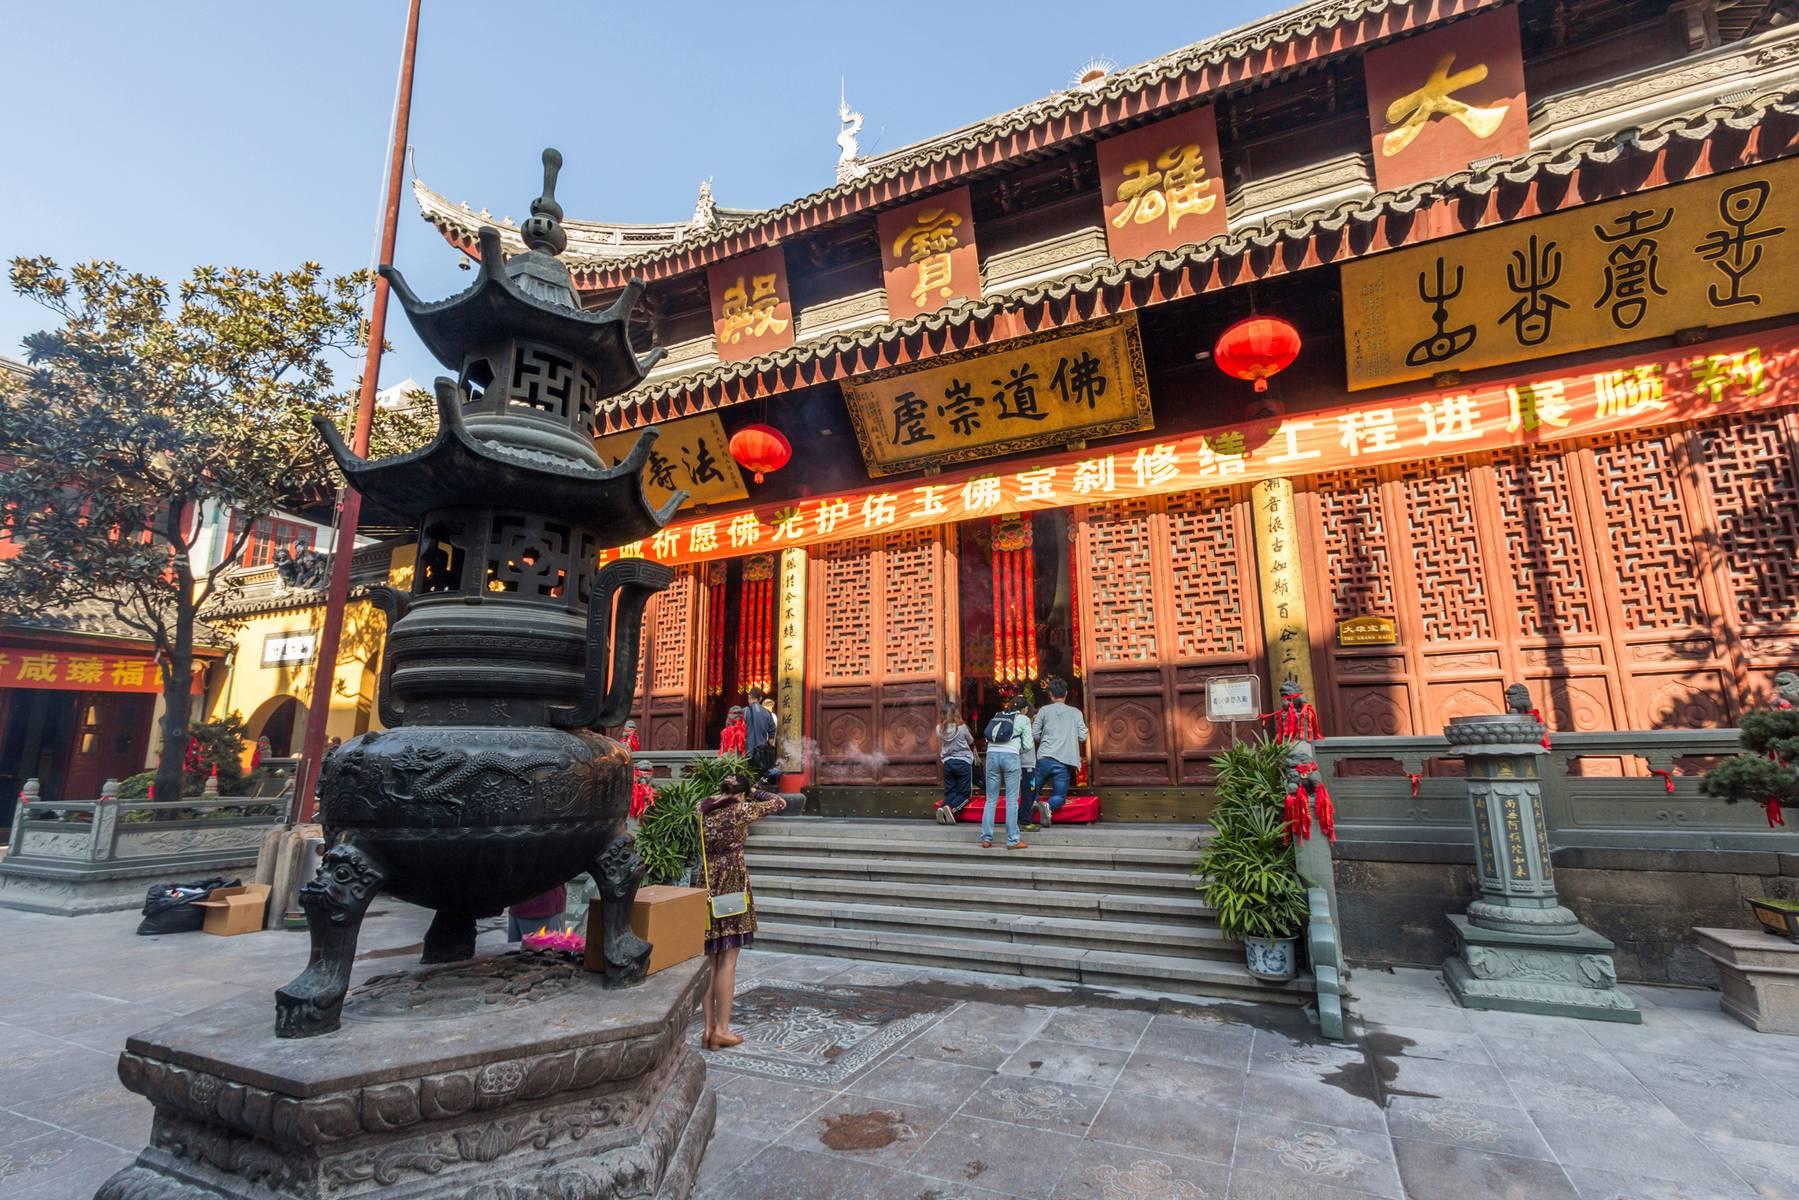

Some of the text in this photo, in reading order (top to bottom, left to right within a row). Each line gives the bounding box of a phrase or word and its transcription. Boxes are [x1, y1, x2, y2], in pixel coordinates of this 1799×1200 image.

[1382, 52, 1509, 157] 大
[720, 273, 788, 344] 殿
[0, 653, 173, 687] 咸臻福
